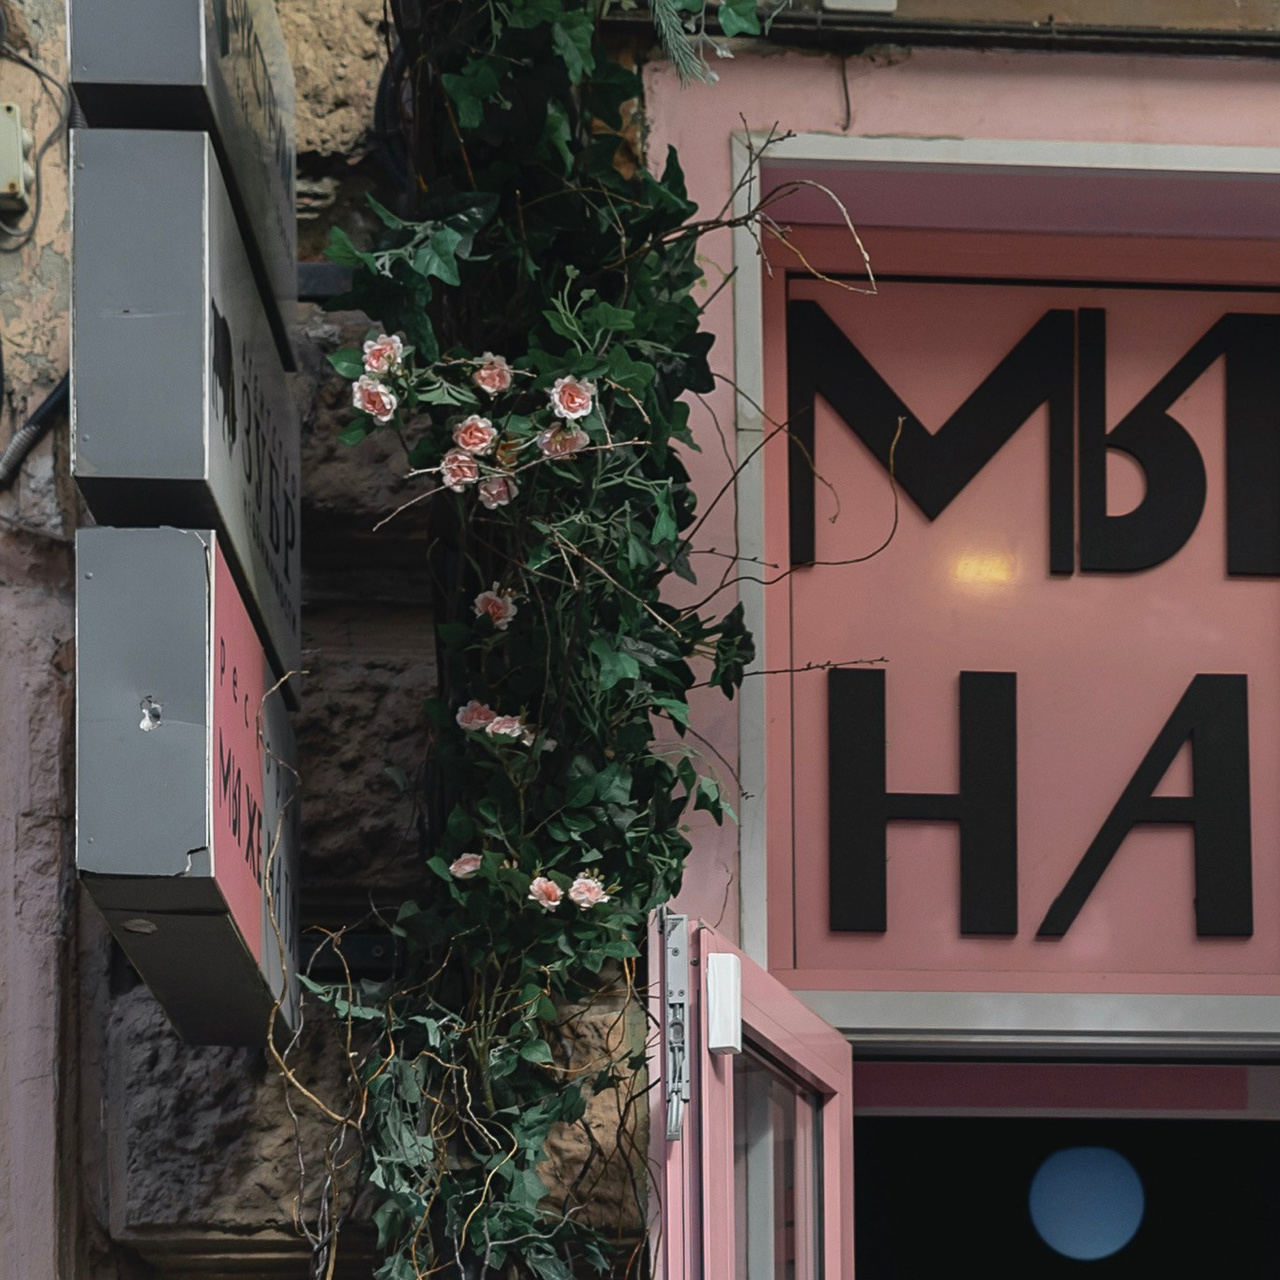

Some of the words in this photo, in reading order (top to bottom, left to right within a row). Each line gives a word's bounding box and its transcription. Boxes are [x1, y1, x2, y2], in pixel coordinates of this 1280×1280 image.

[241, 381, 297, 585] ЗУБР
[245, 782, 263, 889] ЖЕ
[826, 667, 1255, 942] НА
